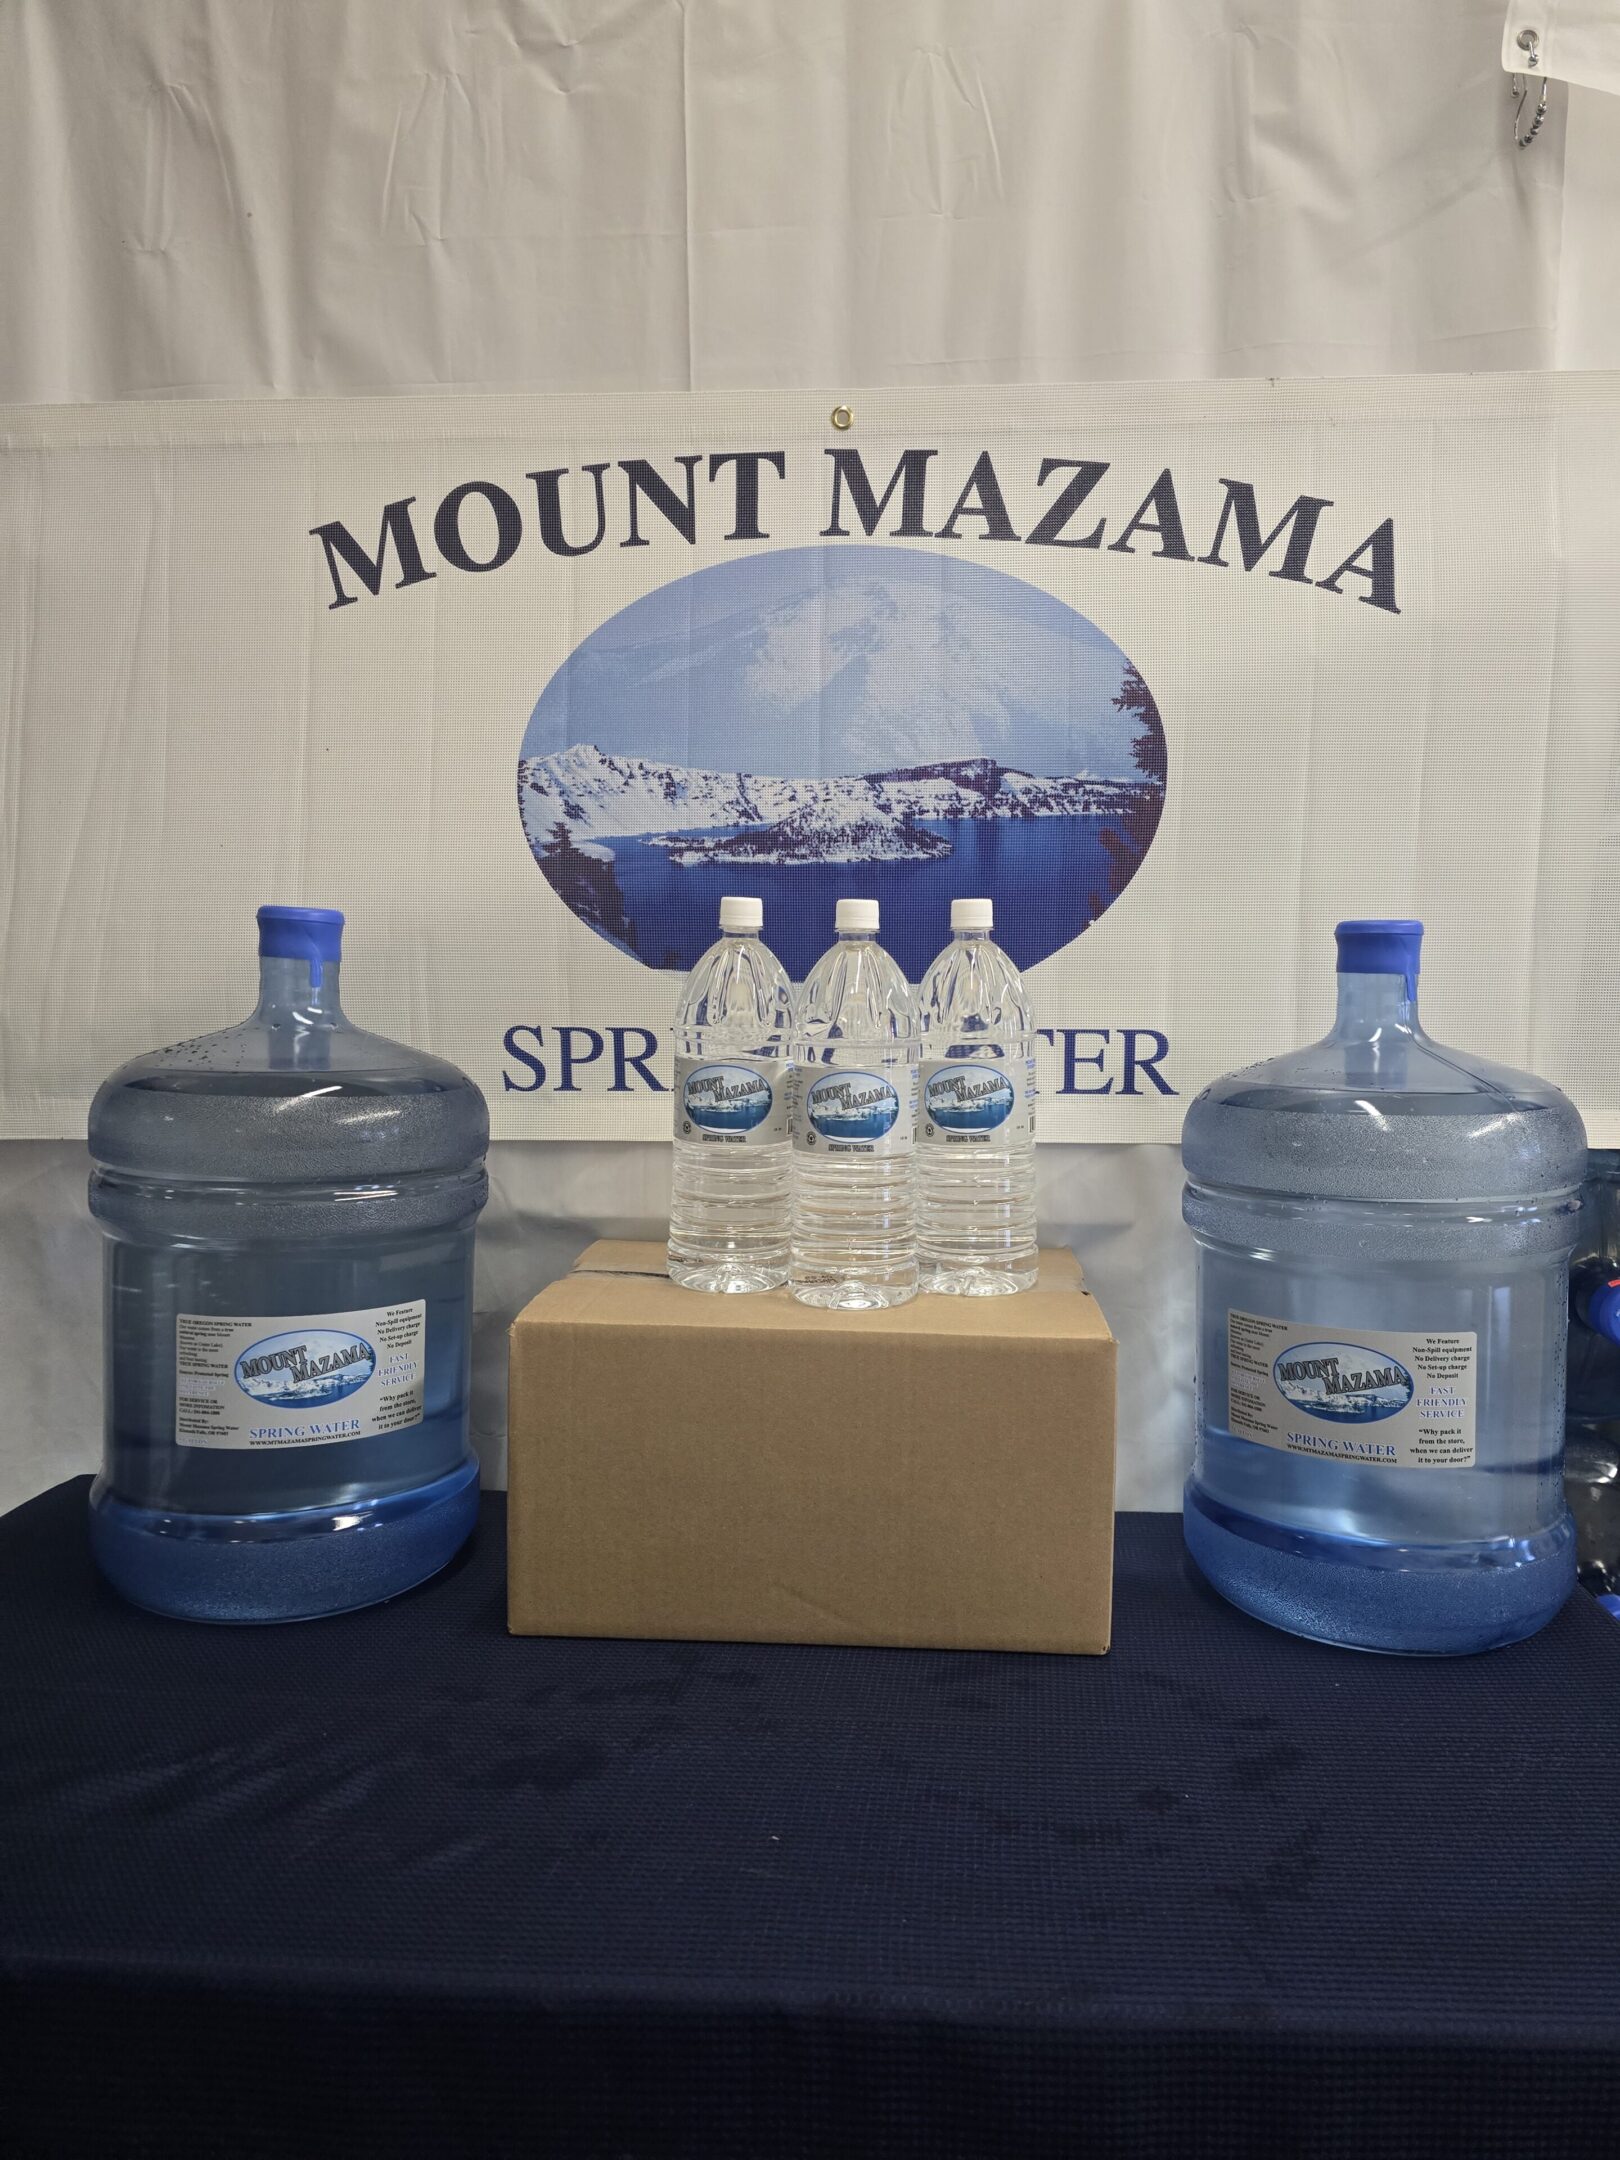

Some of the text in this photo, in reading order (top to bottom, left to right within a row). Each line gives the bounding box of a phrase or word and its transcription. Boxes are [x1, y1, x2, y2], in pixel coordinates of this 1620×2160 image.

[309, 449, 1402, 615] MOUNT MAZAMA
[502, 1025, 674, 1092] SPR
[687, 1075, 724, 1095] MOUNT
[713, 1078, 769, 1102] MAZAMA
[811, 1082, 851, 1104] MOUNT
[927, 1075, 965, 1097] MOUNT
[955, 1076, 1009, 1102] MAZAMA
[840, 1085, 896, 1110] MAZAMA
[240, 1345, 308, 1379] MOUNT
[290, 1342, 370, 1383] MAZAMA
[390, 1352, 409, 1363] FAST
[1425, 1355, 1449, 1363] Delivery
[378, 1361, 417, 1376] FRIENDLY
[1277, 1357, 1339, 1381] MOUNT
[381, 1373, 415, 1386] SERVICE
[1322, 1366, 1406, 1395] MAZAMA
[1431, 1387, 1454, 1395] FAST
[379, 1404, 393, 1412] from
[1416, 1398, 1466, 1407] FRIENDLY
[1420, 1410, 1464, 1418] SERVICE
[249, 1419, 360, 1439] SPRING WATER
[249, 1430, 361, 1446] WWW.MTMAZAMASPRINGWATER.COM
[1440, 1428, 1456, 1436] pack
[1287, 1432, 1396, 1456] SPRING WATER
[1287, 1444, 1398, 1464] WWW.MTMAZAMASPRINGWATER.COM
